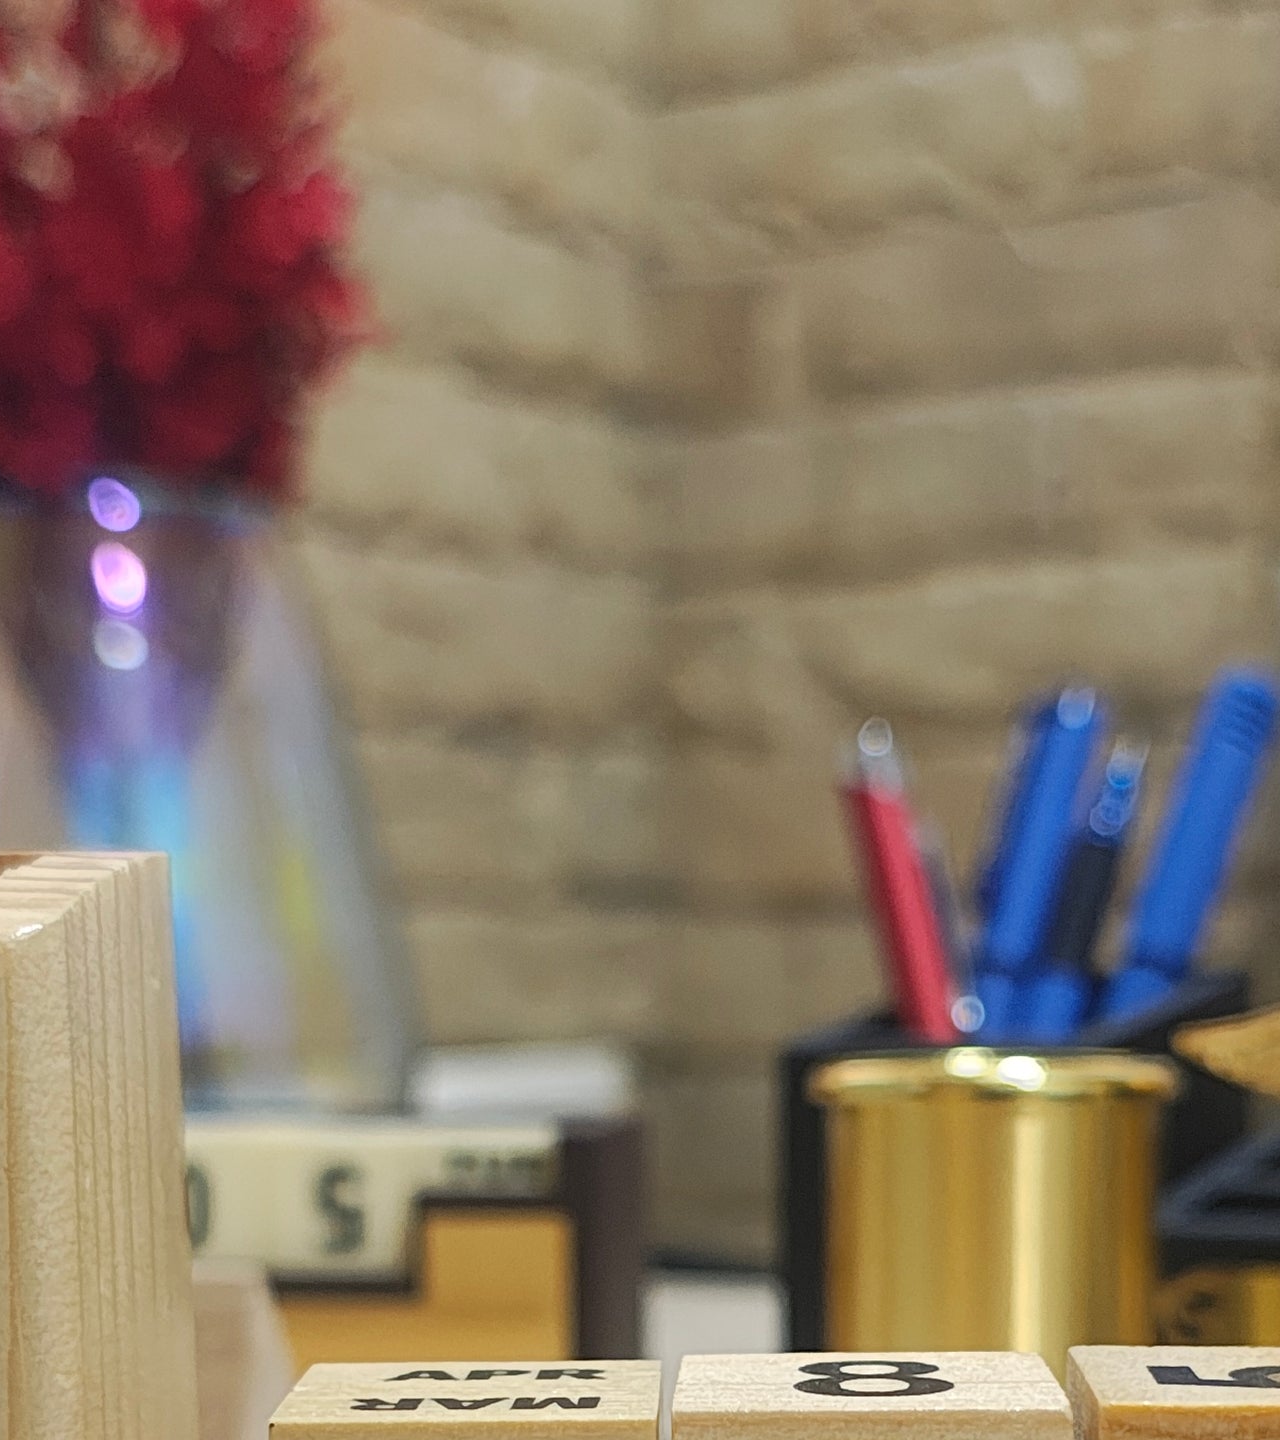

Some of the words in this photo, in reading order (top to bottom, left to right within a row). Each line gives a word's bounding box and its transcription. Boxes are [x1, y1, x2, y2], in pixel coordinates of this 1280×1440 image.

[384, 1368, 607, 1382] APR
[793, 1361, 954, 1397] 8
[350, 1397, 600, 1410] MAR
